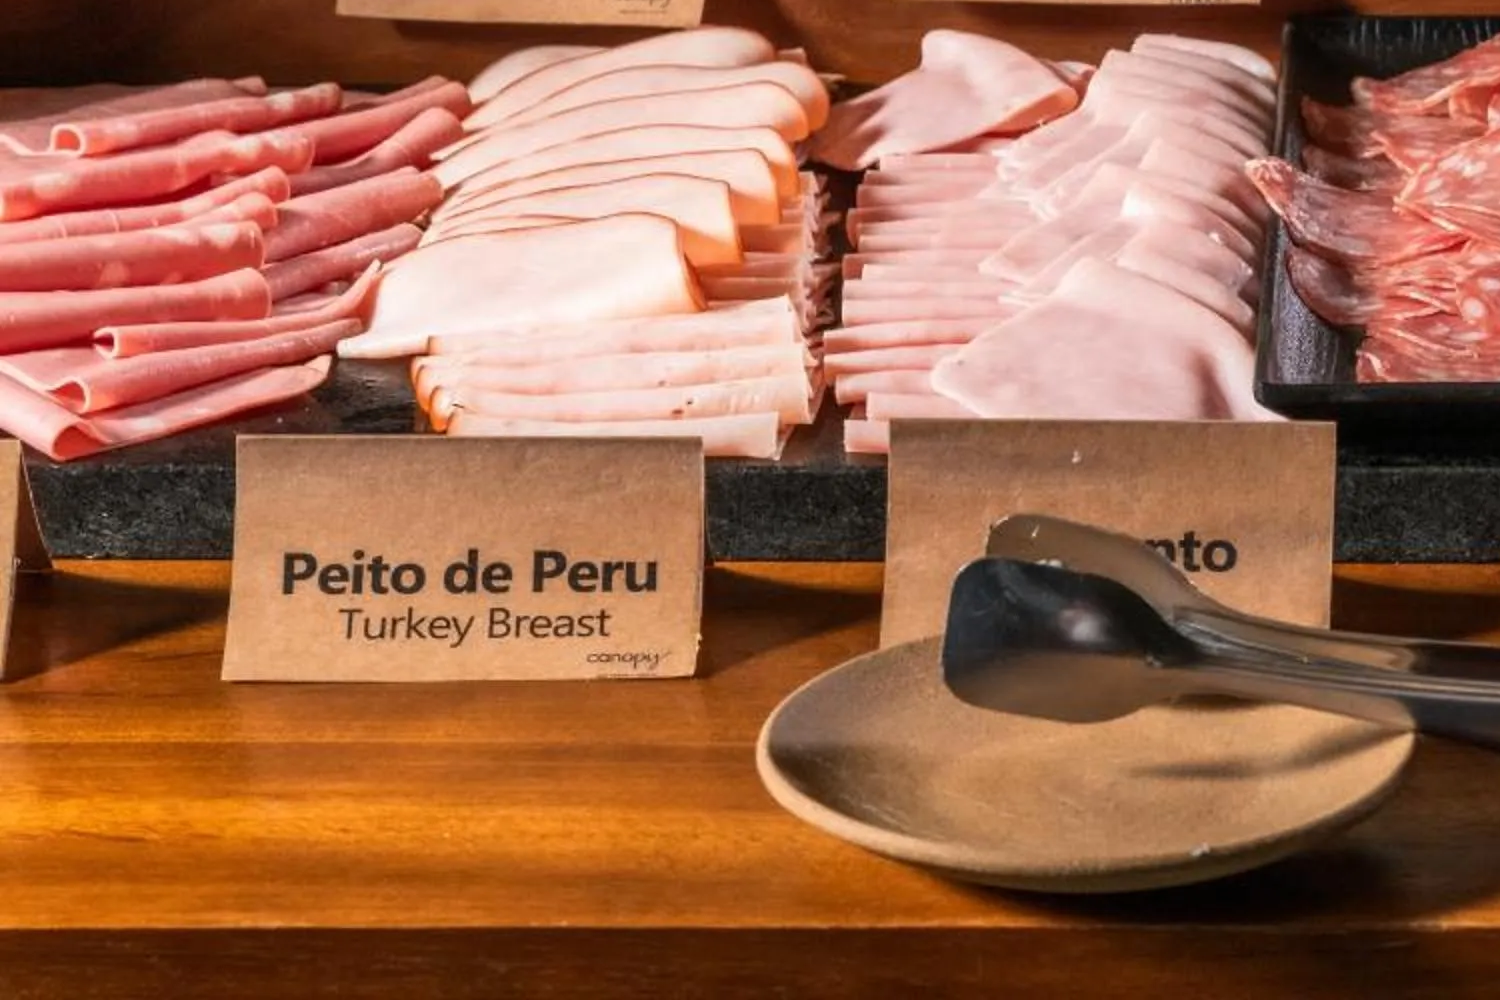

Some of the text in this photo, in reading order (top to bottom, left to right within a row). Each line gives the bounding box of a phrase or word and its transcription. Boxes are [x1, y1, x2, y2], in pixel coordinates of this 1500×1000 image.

[282, 547, 657, 595] Peito de Peru
[338, 605, 612, 648] Turkey Breast
[585, 651, 661, 670] canopy
